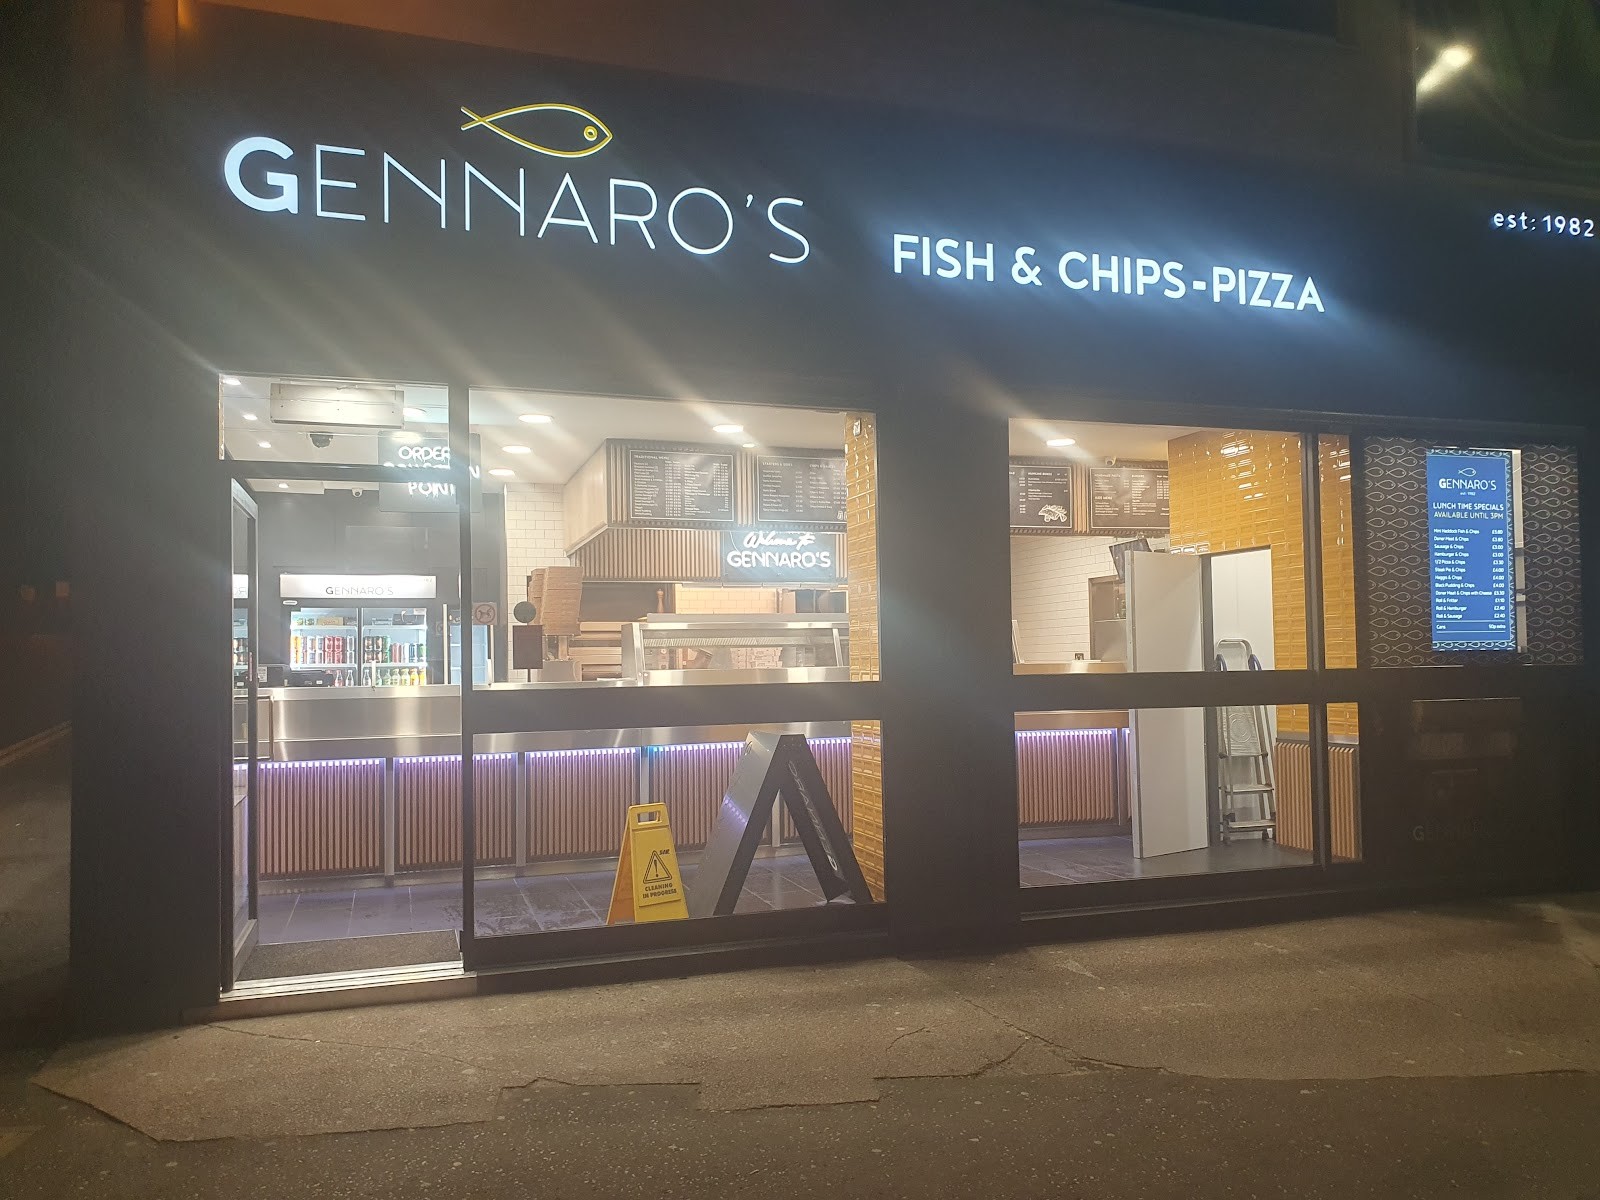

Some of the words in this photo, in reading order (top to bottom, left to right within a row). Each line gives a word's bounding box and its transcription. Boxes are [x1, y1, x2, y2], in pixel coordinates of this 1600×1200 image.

[223, 136, 811, 264] GENNARO'S
[1493, 211, 1536, 232] est:
[1541, 214, 1595, 238] 1982
[893, 233, 995, 282] FISH
[1011, 246, 1043, 286] &
[398, 445, 450, 461] ORDER
[1438, 478, 1497, 490] GENNARO'S
[1474, 503, 1504, 511] SPECIALS
[727, 550, 831, 569] GENNARO'S
[645, 882, 673, 892] CLEANING
